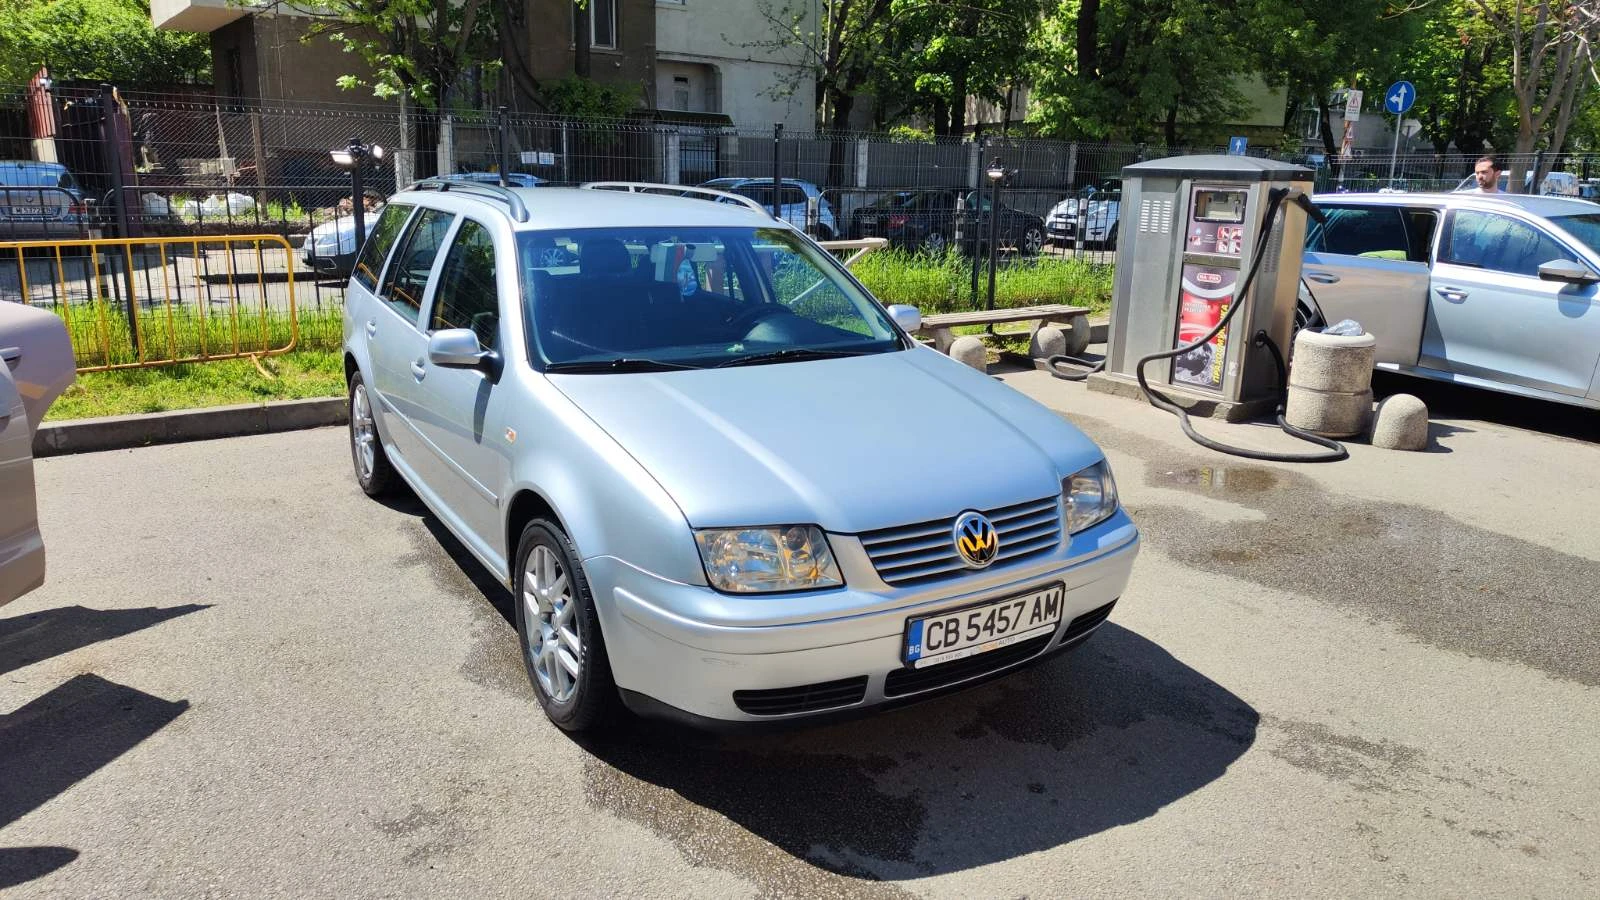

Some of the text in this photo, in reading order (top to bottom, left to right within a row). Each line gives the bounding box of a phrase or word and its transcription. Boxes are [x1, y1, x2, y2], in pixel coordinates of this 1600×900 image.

[926, 590, 1060, 651] CB 5457 AM
[909, 645, 921, 655] BG
